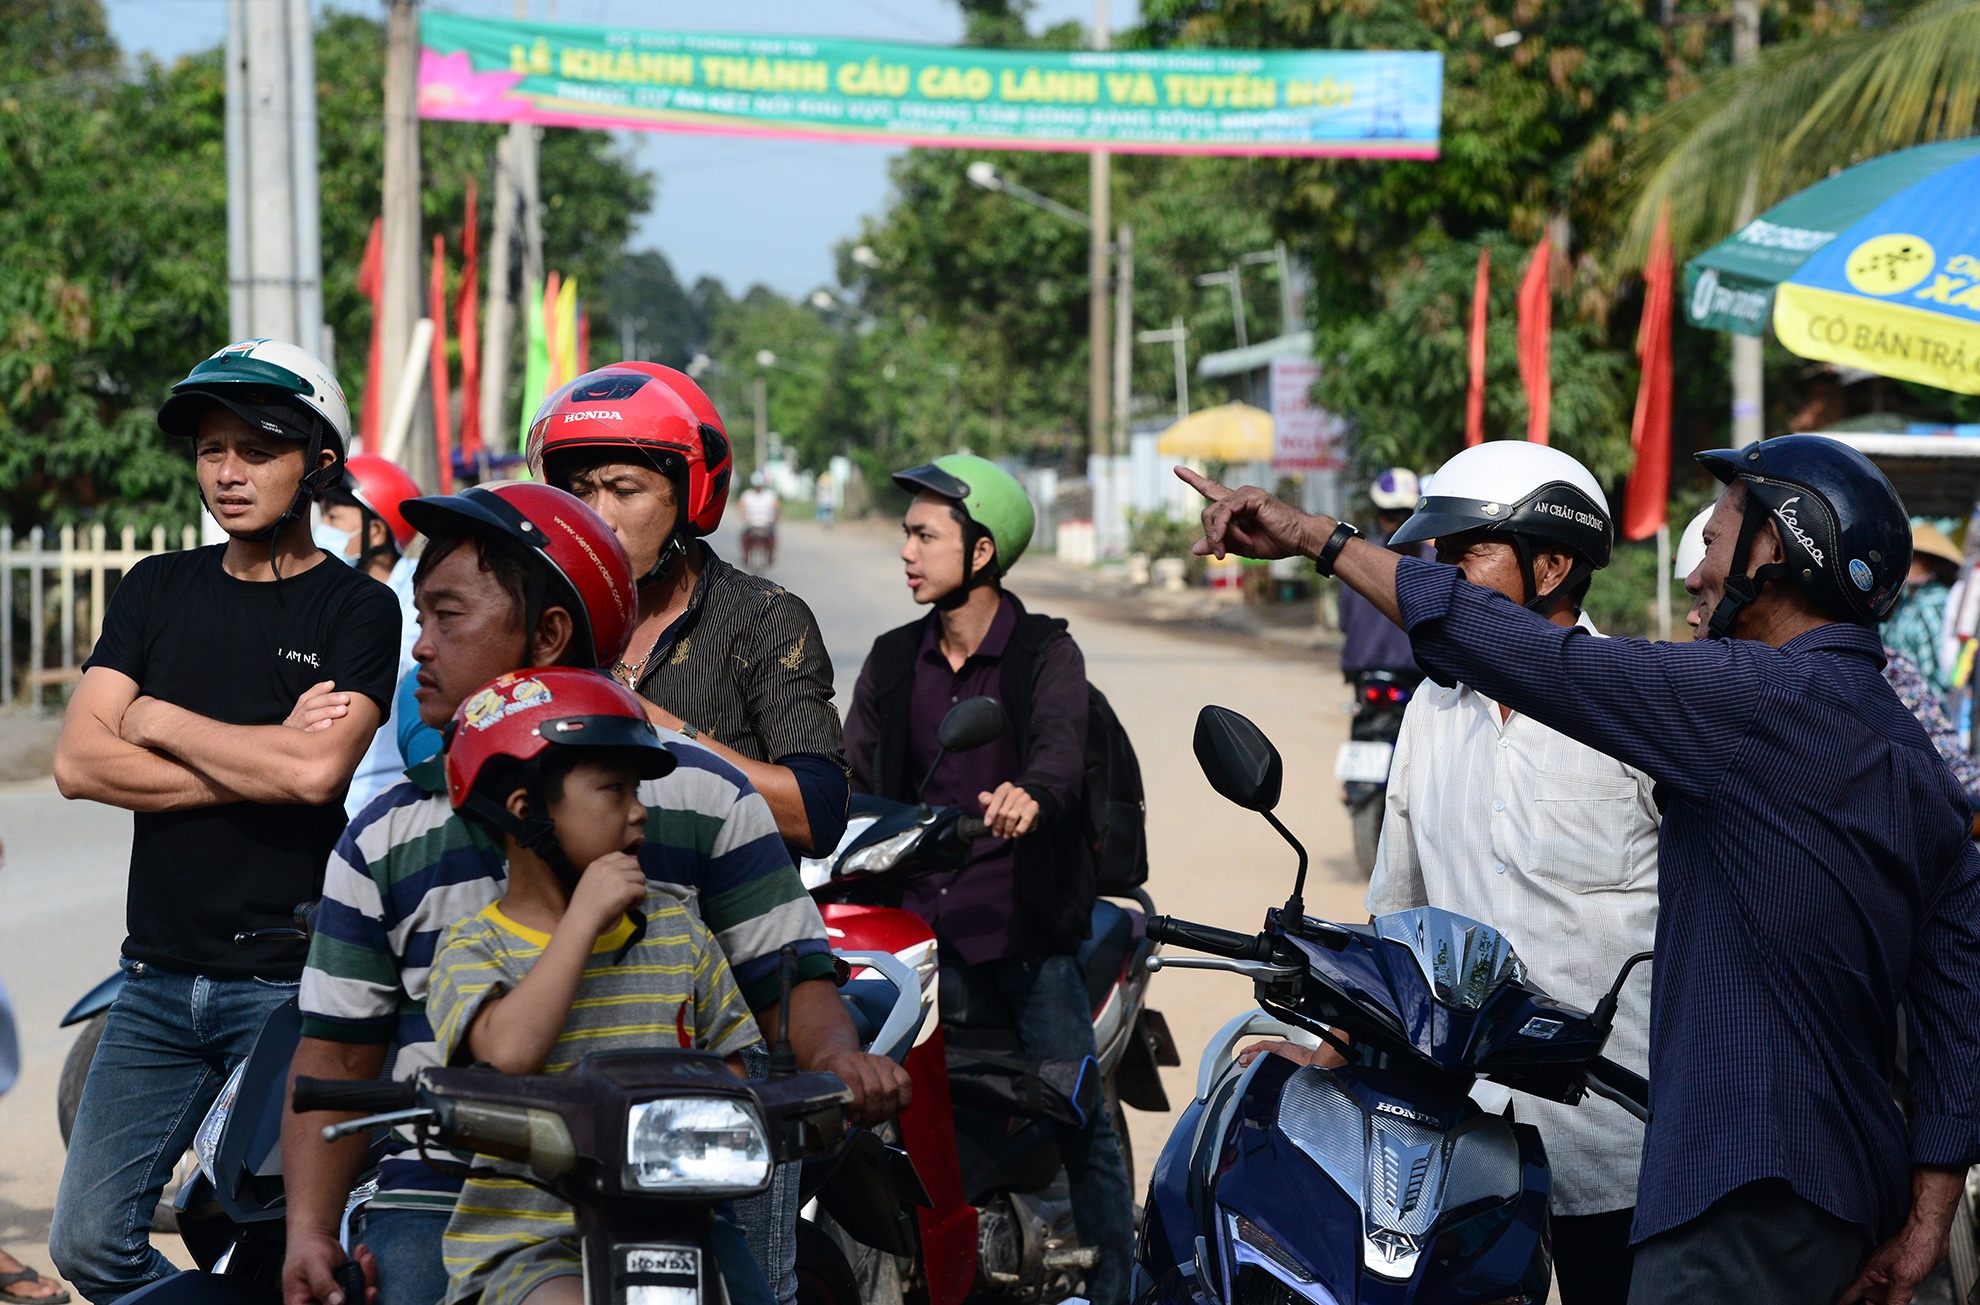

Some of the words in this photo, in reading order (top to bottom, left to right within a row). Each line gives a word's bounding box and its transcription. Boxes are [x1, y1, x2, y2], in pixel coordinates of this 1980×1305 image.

[560, 44, 694, 86] KHÁNH
[702, 53, 829, 94] THÀNH
[917, 64, 993, 100] CAO
[564, 410, 623, 424] HONDA
[1534, 501, 1549, 514] AN
[1549, 504, 1575, 521] CHÂU
[1773, 497, 1824, 568] Vespa
[277, 647, 283, 656] I
[286, 650, 301, 663] AM
[1376, 1100, 1443, 1129] HONDA
[631, 1256, 693, 1271] HONDA
